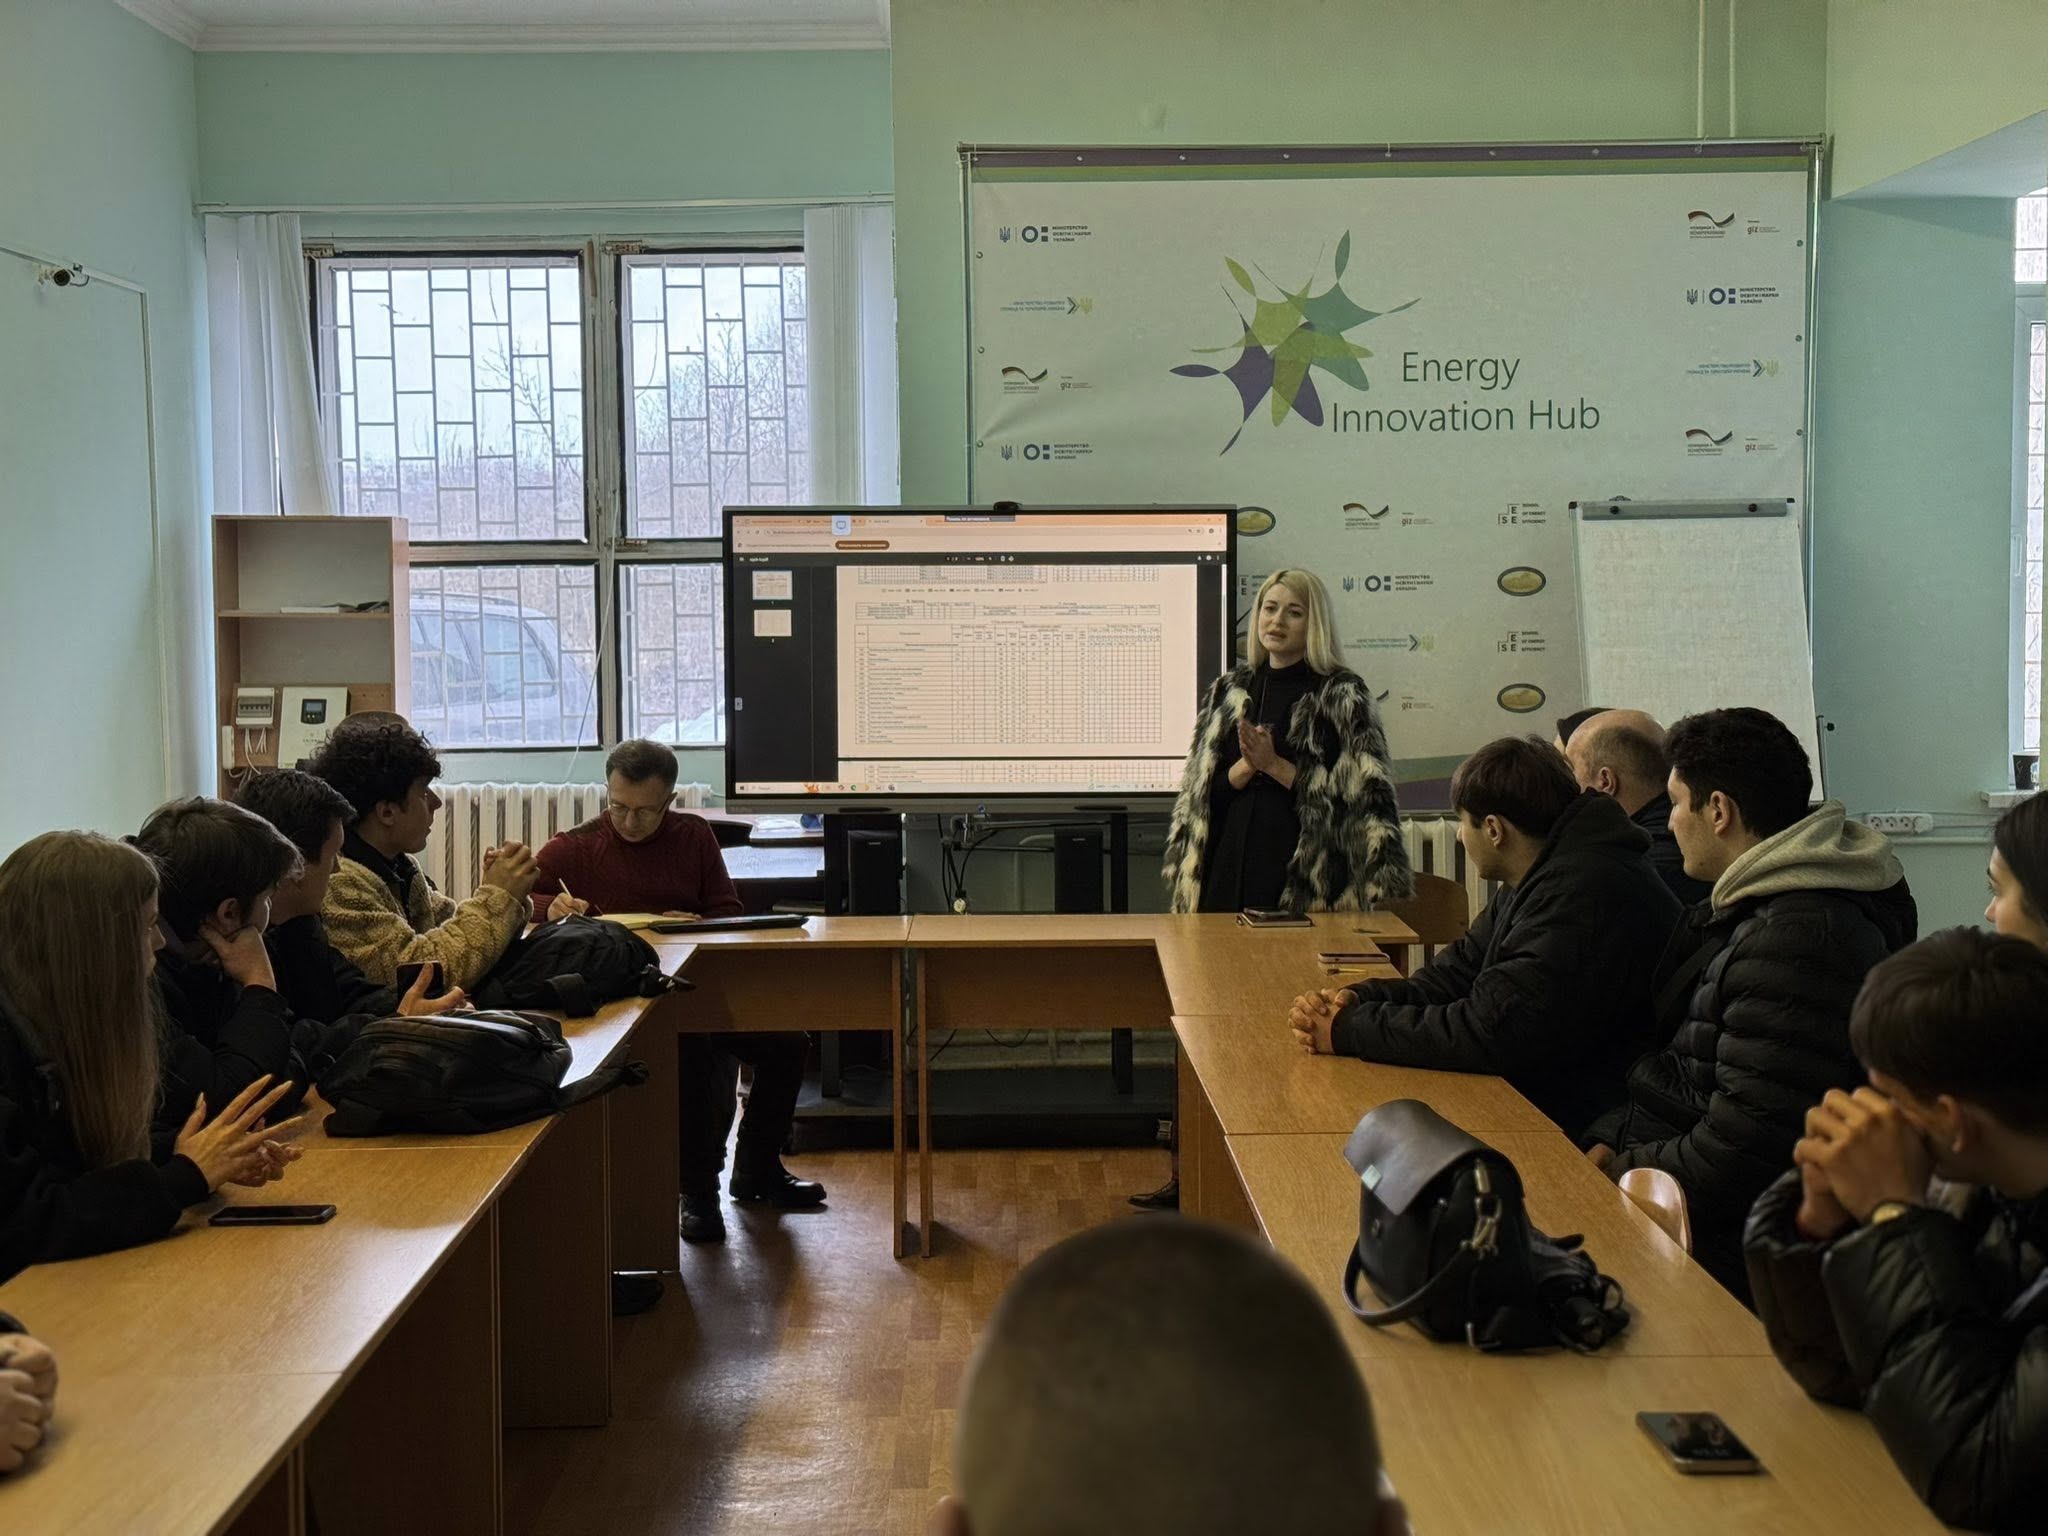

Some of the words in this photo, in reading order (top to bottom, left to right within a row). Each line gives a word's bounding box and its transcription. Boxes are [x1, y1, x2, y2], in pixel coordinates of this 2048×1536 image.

[1747, 226, 1759, 235] giz
[1404, 351, 1521, 391] Energy
[1333, 401, 1514, 433] Innovation
[1530, 398, 1600, 430] Hub
[1745, 444, 1756, 452] giz
[1511, 506, 1517, 514] E
[1401, 518, 1412, 527] giz
[1502, 516, 1508, 524] S
[1511, 516, 1517, 524] E
[1511, 634, 1517, 642] E
[1501, 644, 1507, 652] S
[1511, 644, 1516, 652] E
